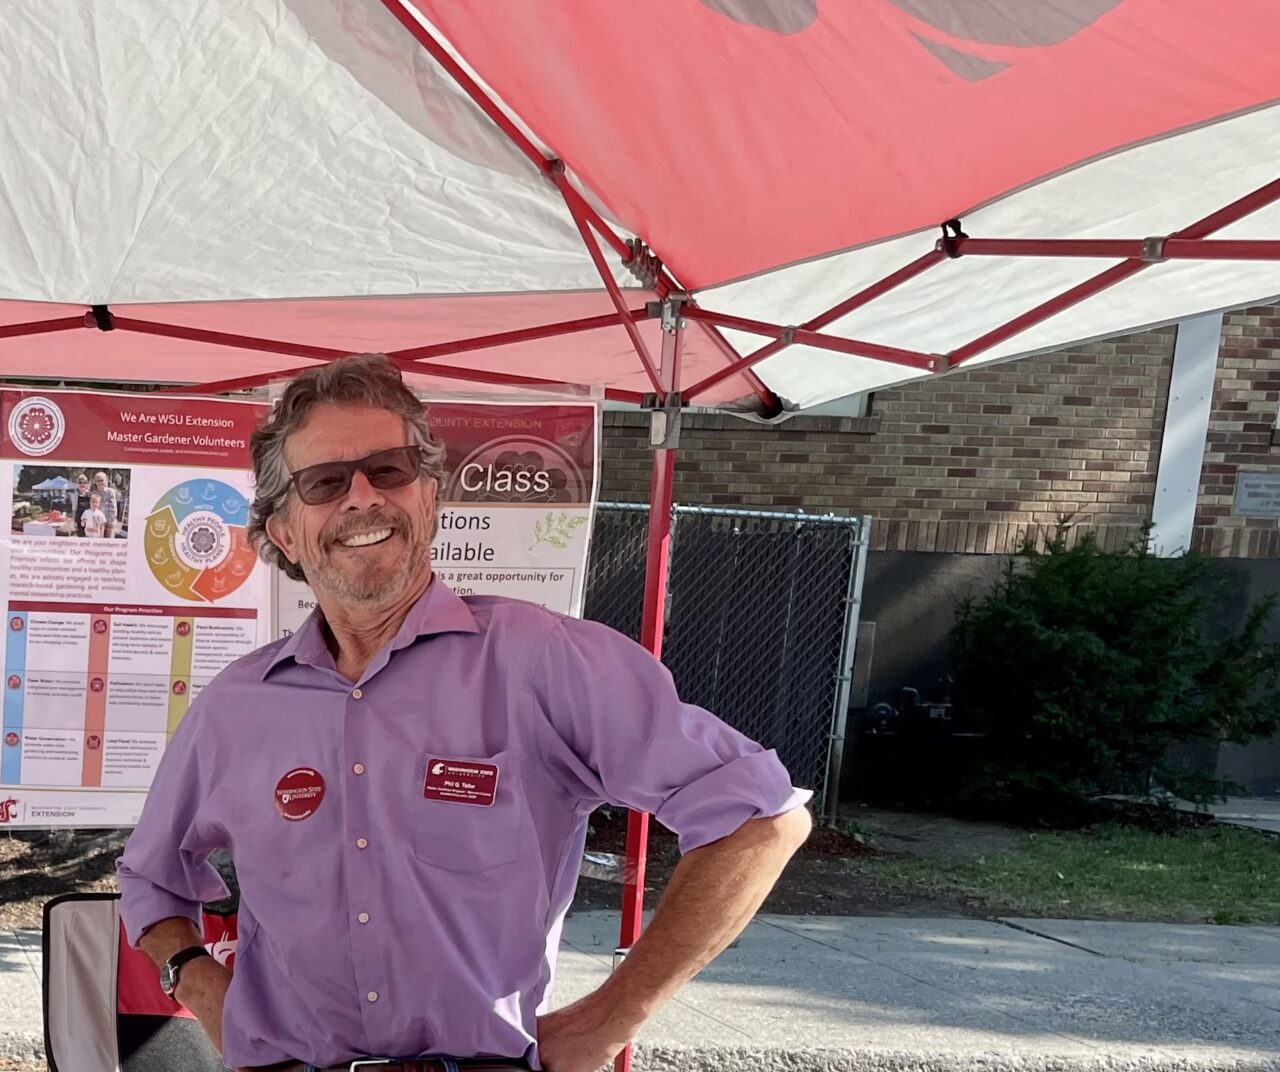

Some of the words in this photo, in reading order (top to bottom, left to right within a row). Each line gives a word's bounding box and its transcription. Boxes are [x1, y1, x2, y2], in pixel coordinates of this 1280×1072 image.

[120, 412, 137, 424] We
[139, 413, 156, 424] Are
[158, 414, 183, 425] WSU
[186, 416, 234, 428] Extension
[474, 418, 542, 429] EXTENSION
[107, 431, 143, 442] Master
[144, 433, 190, 445] Gardener
[193, 435, 245, 449] Volunteers
[461, 463, 550, 492] Class
[182, 517, 206, 536] HEALTHY
[207, 517, 225, 537] PEOPLE
[180, 542, 204, 564] HEALTHY
[205, 545, 225, 563] PLANET
[438, 572, 446, 580] is
[457, 572, 483, 582] great
[486, 572, 546, 583] opportunity
[550, 572, 564, 581] for
[103, 606, 115, 614] Our
[116, 607, 137, 615] Program
[31, 810, 75, 818] EXTENSION
